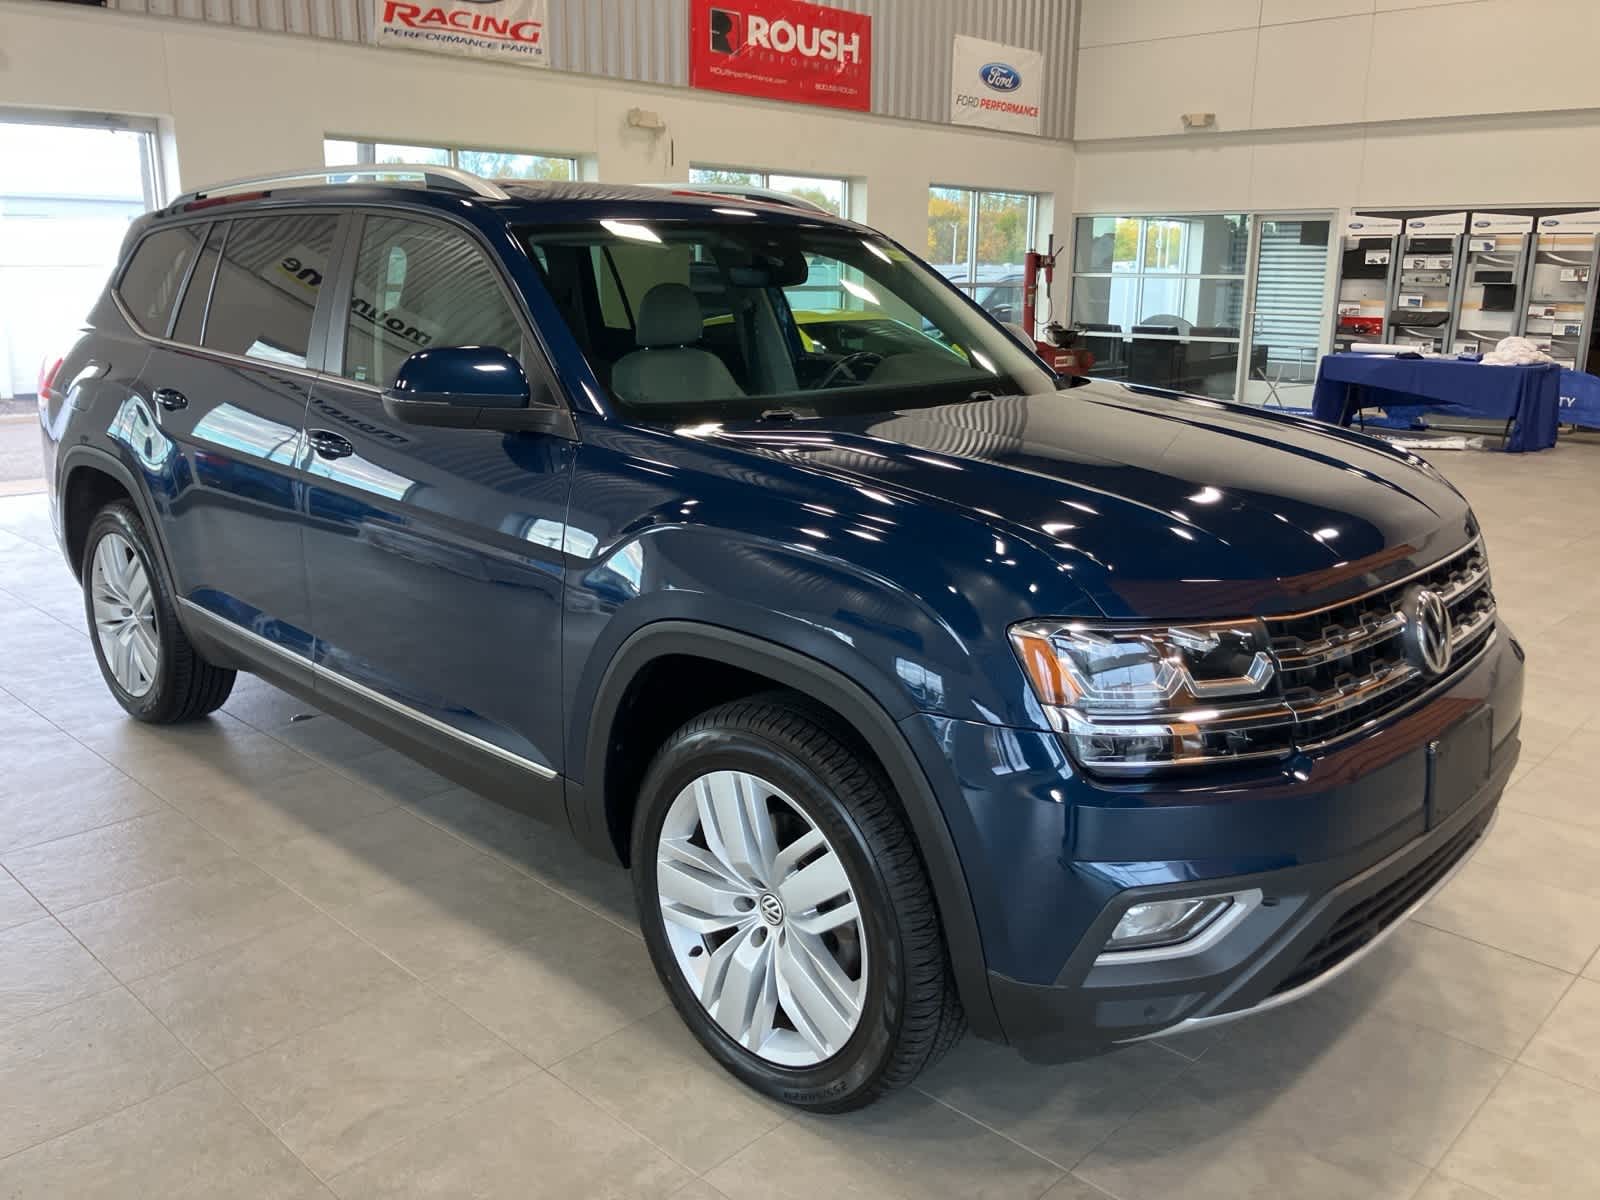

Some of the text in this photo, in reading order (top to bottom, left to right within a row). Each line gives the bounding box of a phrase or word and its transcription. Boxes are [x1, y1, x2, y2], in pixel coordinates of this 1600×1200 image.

[383, 2, 542, 43] RACING
[383, 27, 543, 55] PERFORMANCE PARTS
[747, 15, 860, 64] ROUSH
[987, 66, 1014, 88] Ford
[956, 95, 1039, 117] FORD PERFORMANCE
